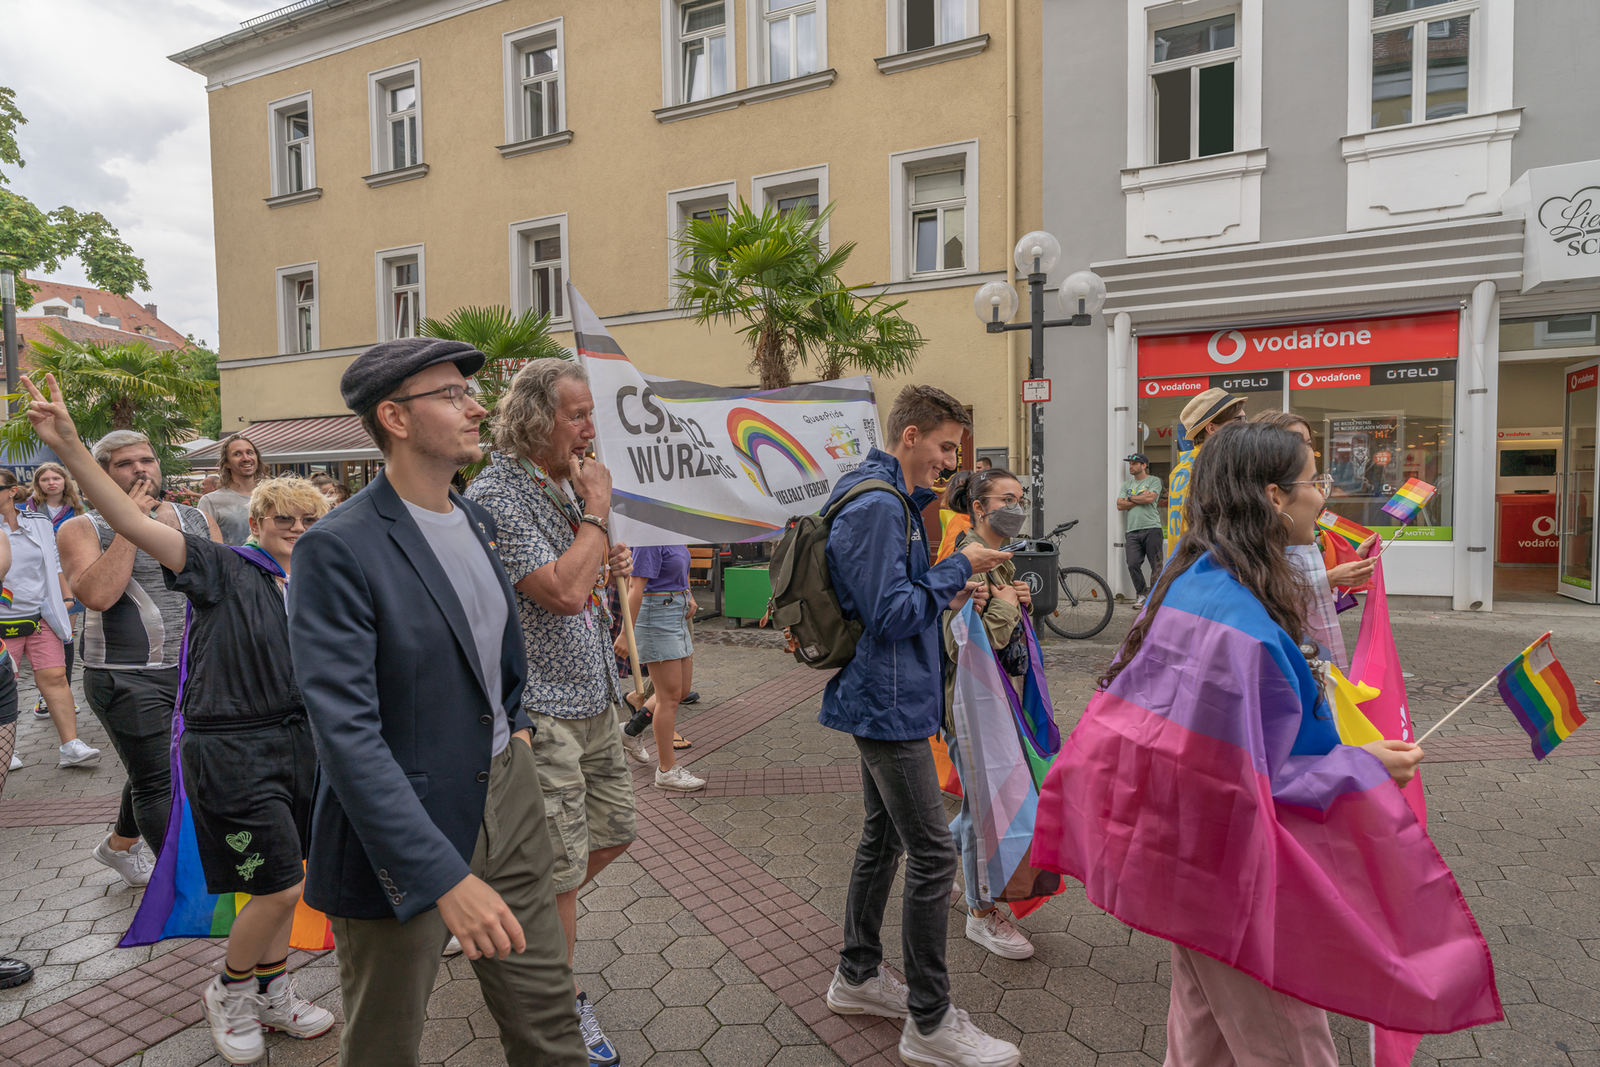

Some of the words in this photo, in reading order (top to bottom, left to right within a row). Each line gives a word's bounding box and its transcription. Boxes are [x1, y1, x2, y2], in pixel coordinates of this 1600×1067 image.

[1567, 238, 1600, 257] SC
[1253, 328, 1371, 352] vodafone
[1315, 373, 1361, 382] vodafone
[1161, 382, 1201, 391] vodafone
[802, 410, 844, 424] QueerPride
[773, 486, 805, 505] VIELFALT
[803, 479, 830, 498] VEREINT
